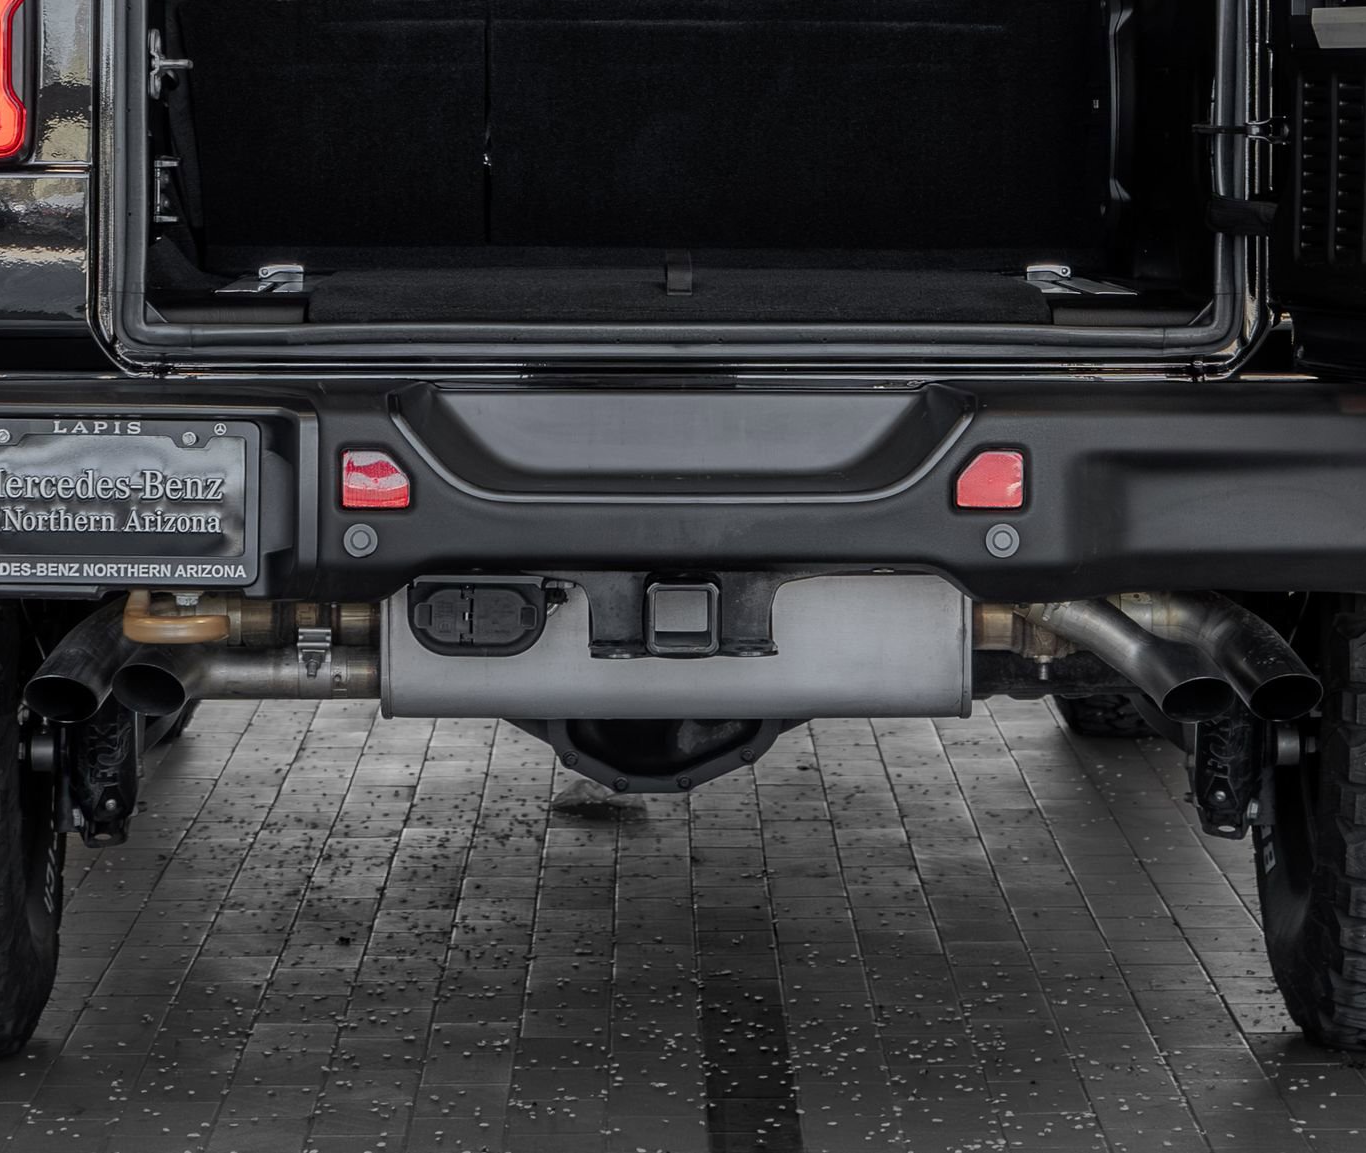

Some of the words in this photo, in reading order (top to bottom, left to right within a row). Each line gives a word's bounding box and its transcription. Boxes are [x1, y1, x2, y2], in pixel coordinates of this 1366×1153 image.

[53, 420, 142, 435] LAPIS
[2, 507, 115, 532] Northern
[123, 507, 222, 533] Arizona
[83, 563, 172, 578] NORTHERN
[174, 564, 247, 579] ARIZONA
